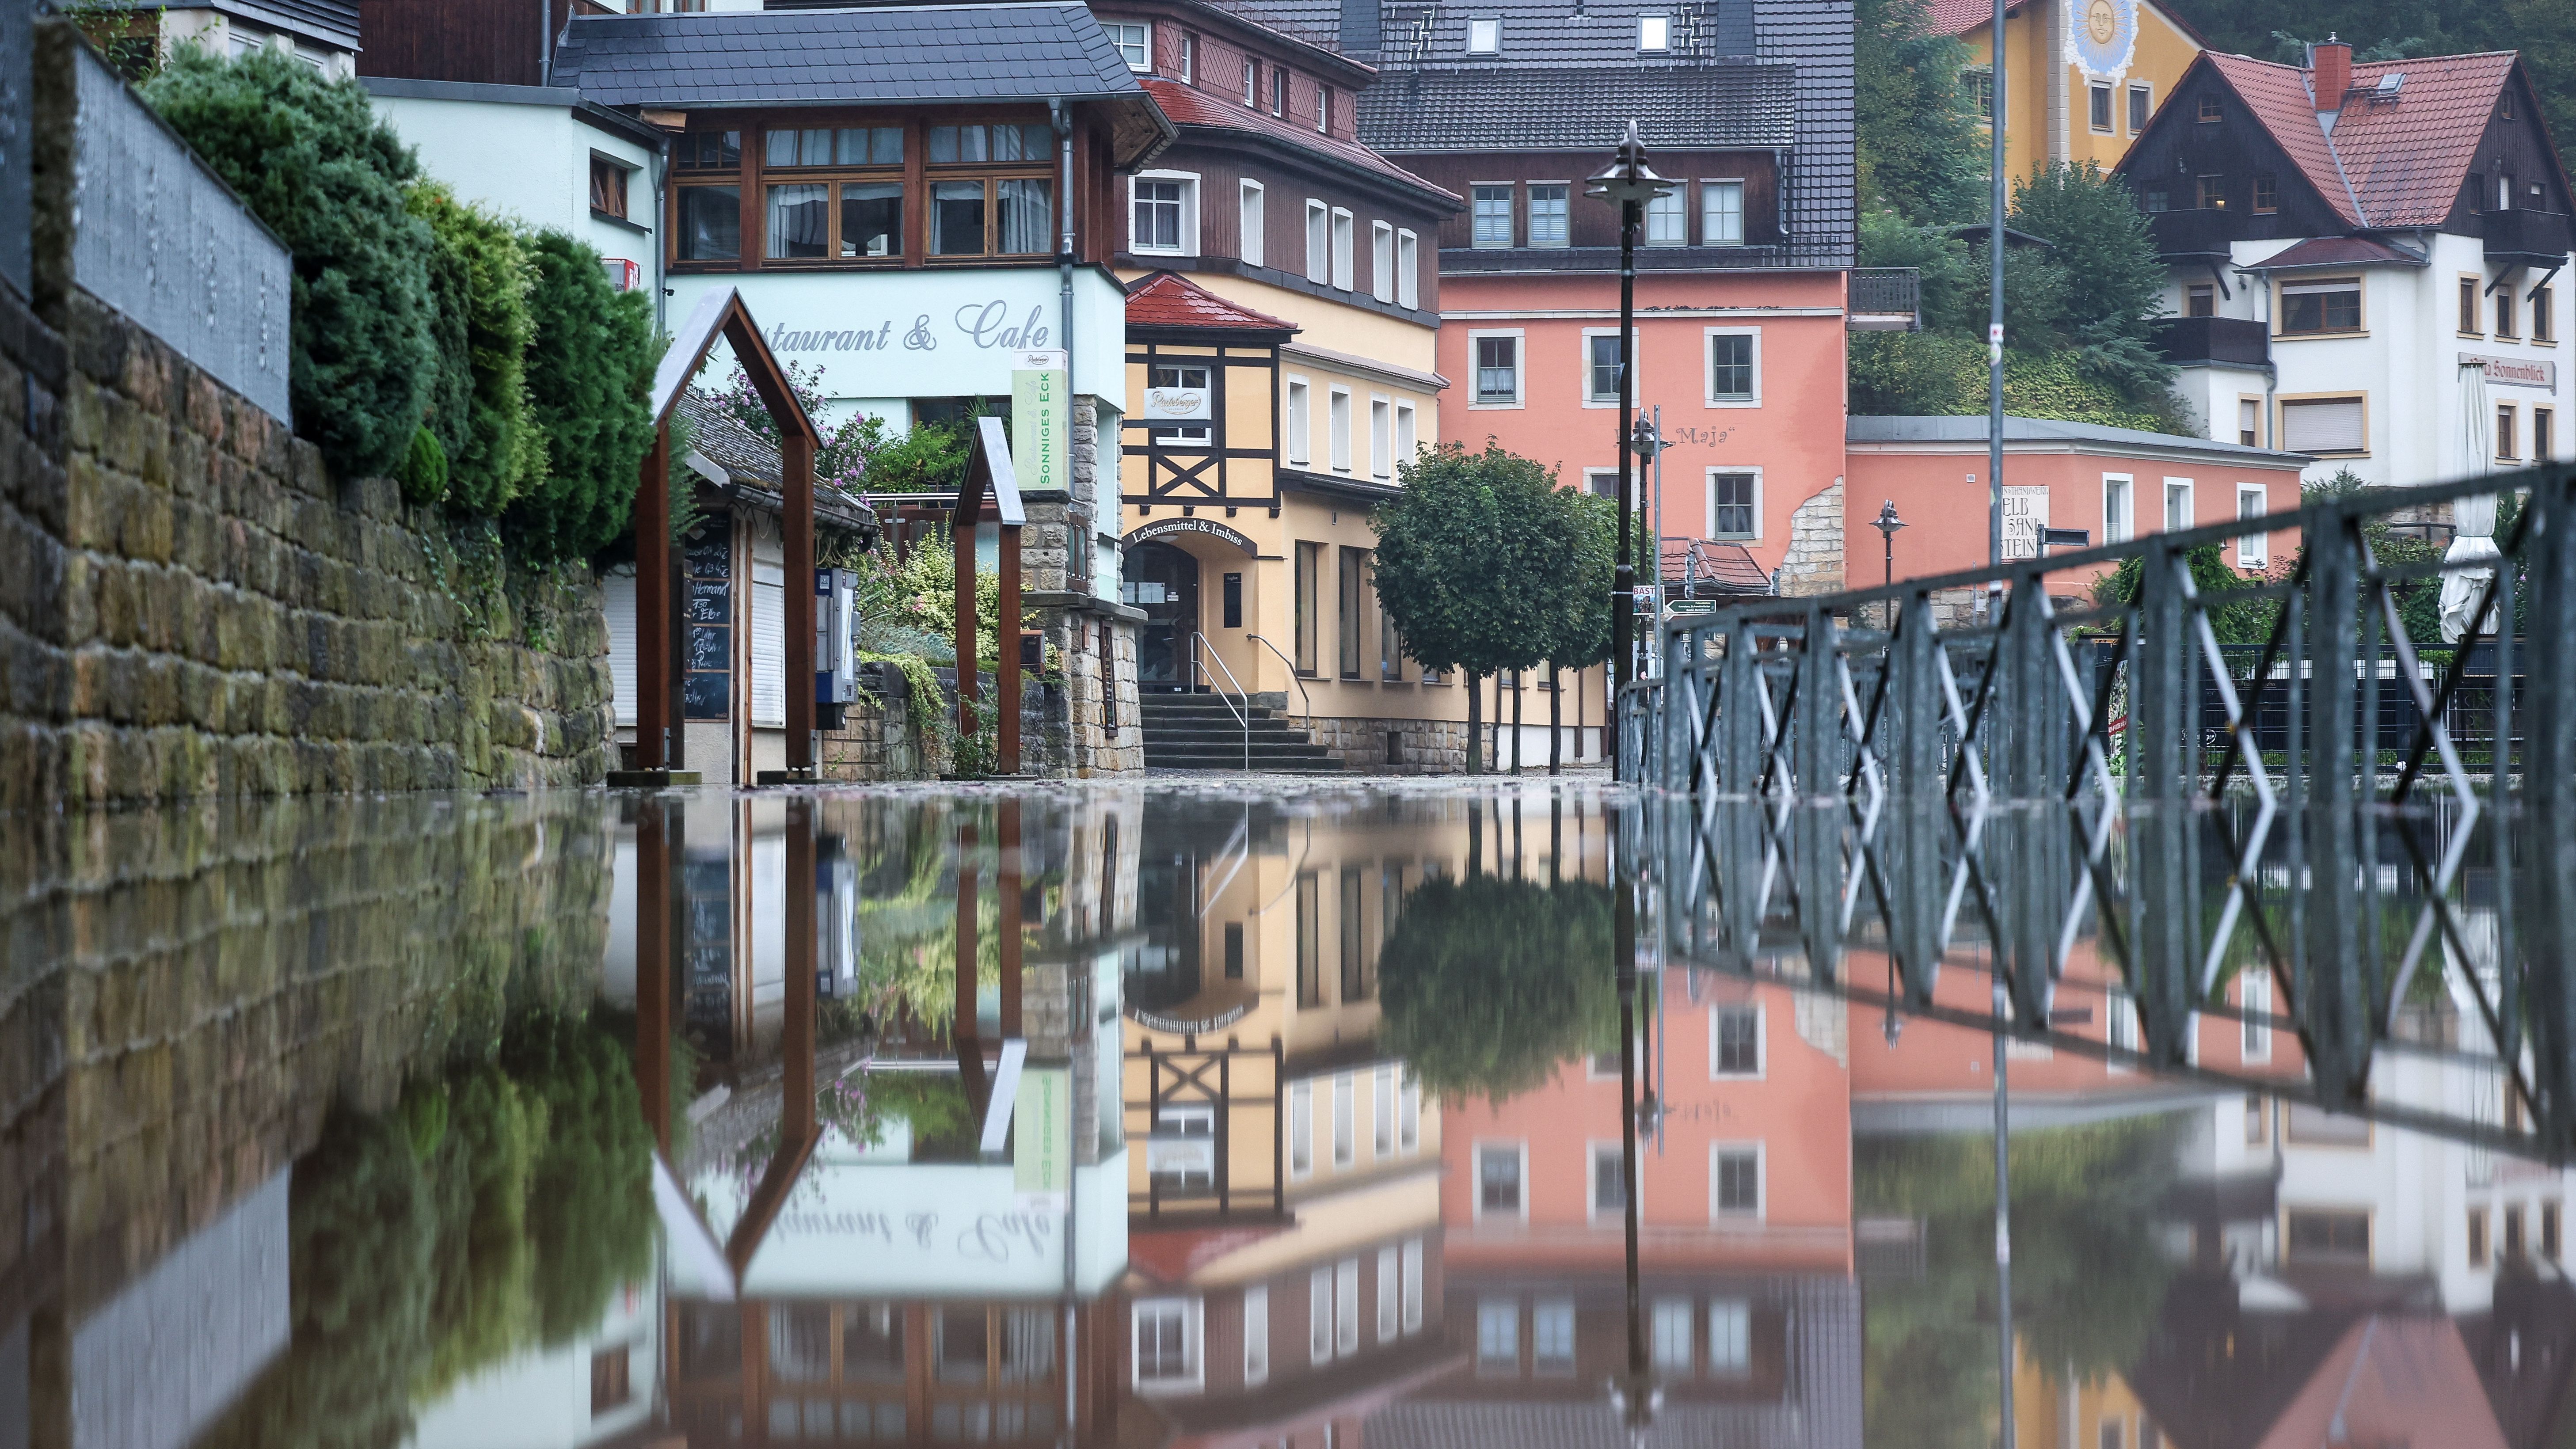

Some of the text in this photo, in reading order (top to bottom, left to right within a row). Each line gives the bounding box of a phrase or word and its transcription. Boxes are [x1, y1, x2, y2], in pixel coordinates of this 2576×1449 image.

[764, 300, 1049, 352] taurant & Cafe
[2494, 360, 2544, 382] Sonnenblick
[1040, 373, 1050, 484] SONNIGES ECK
[2003, 498, 2028, 516] ELB
[1132, 520, 1242, 546] Lebensmittel & Imbiss
